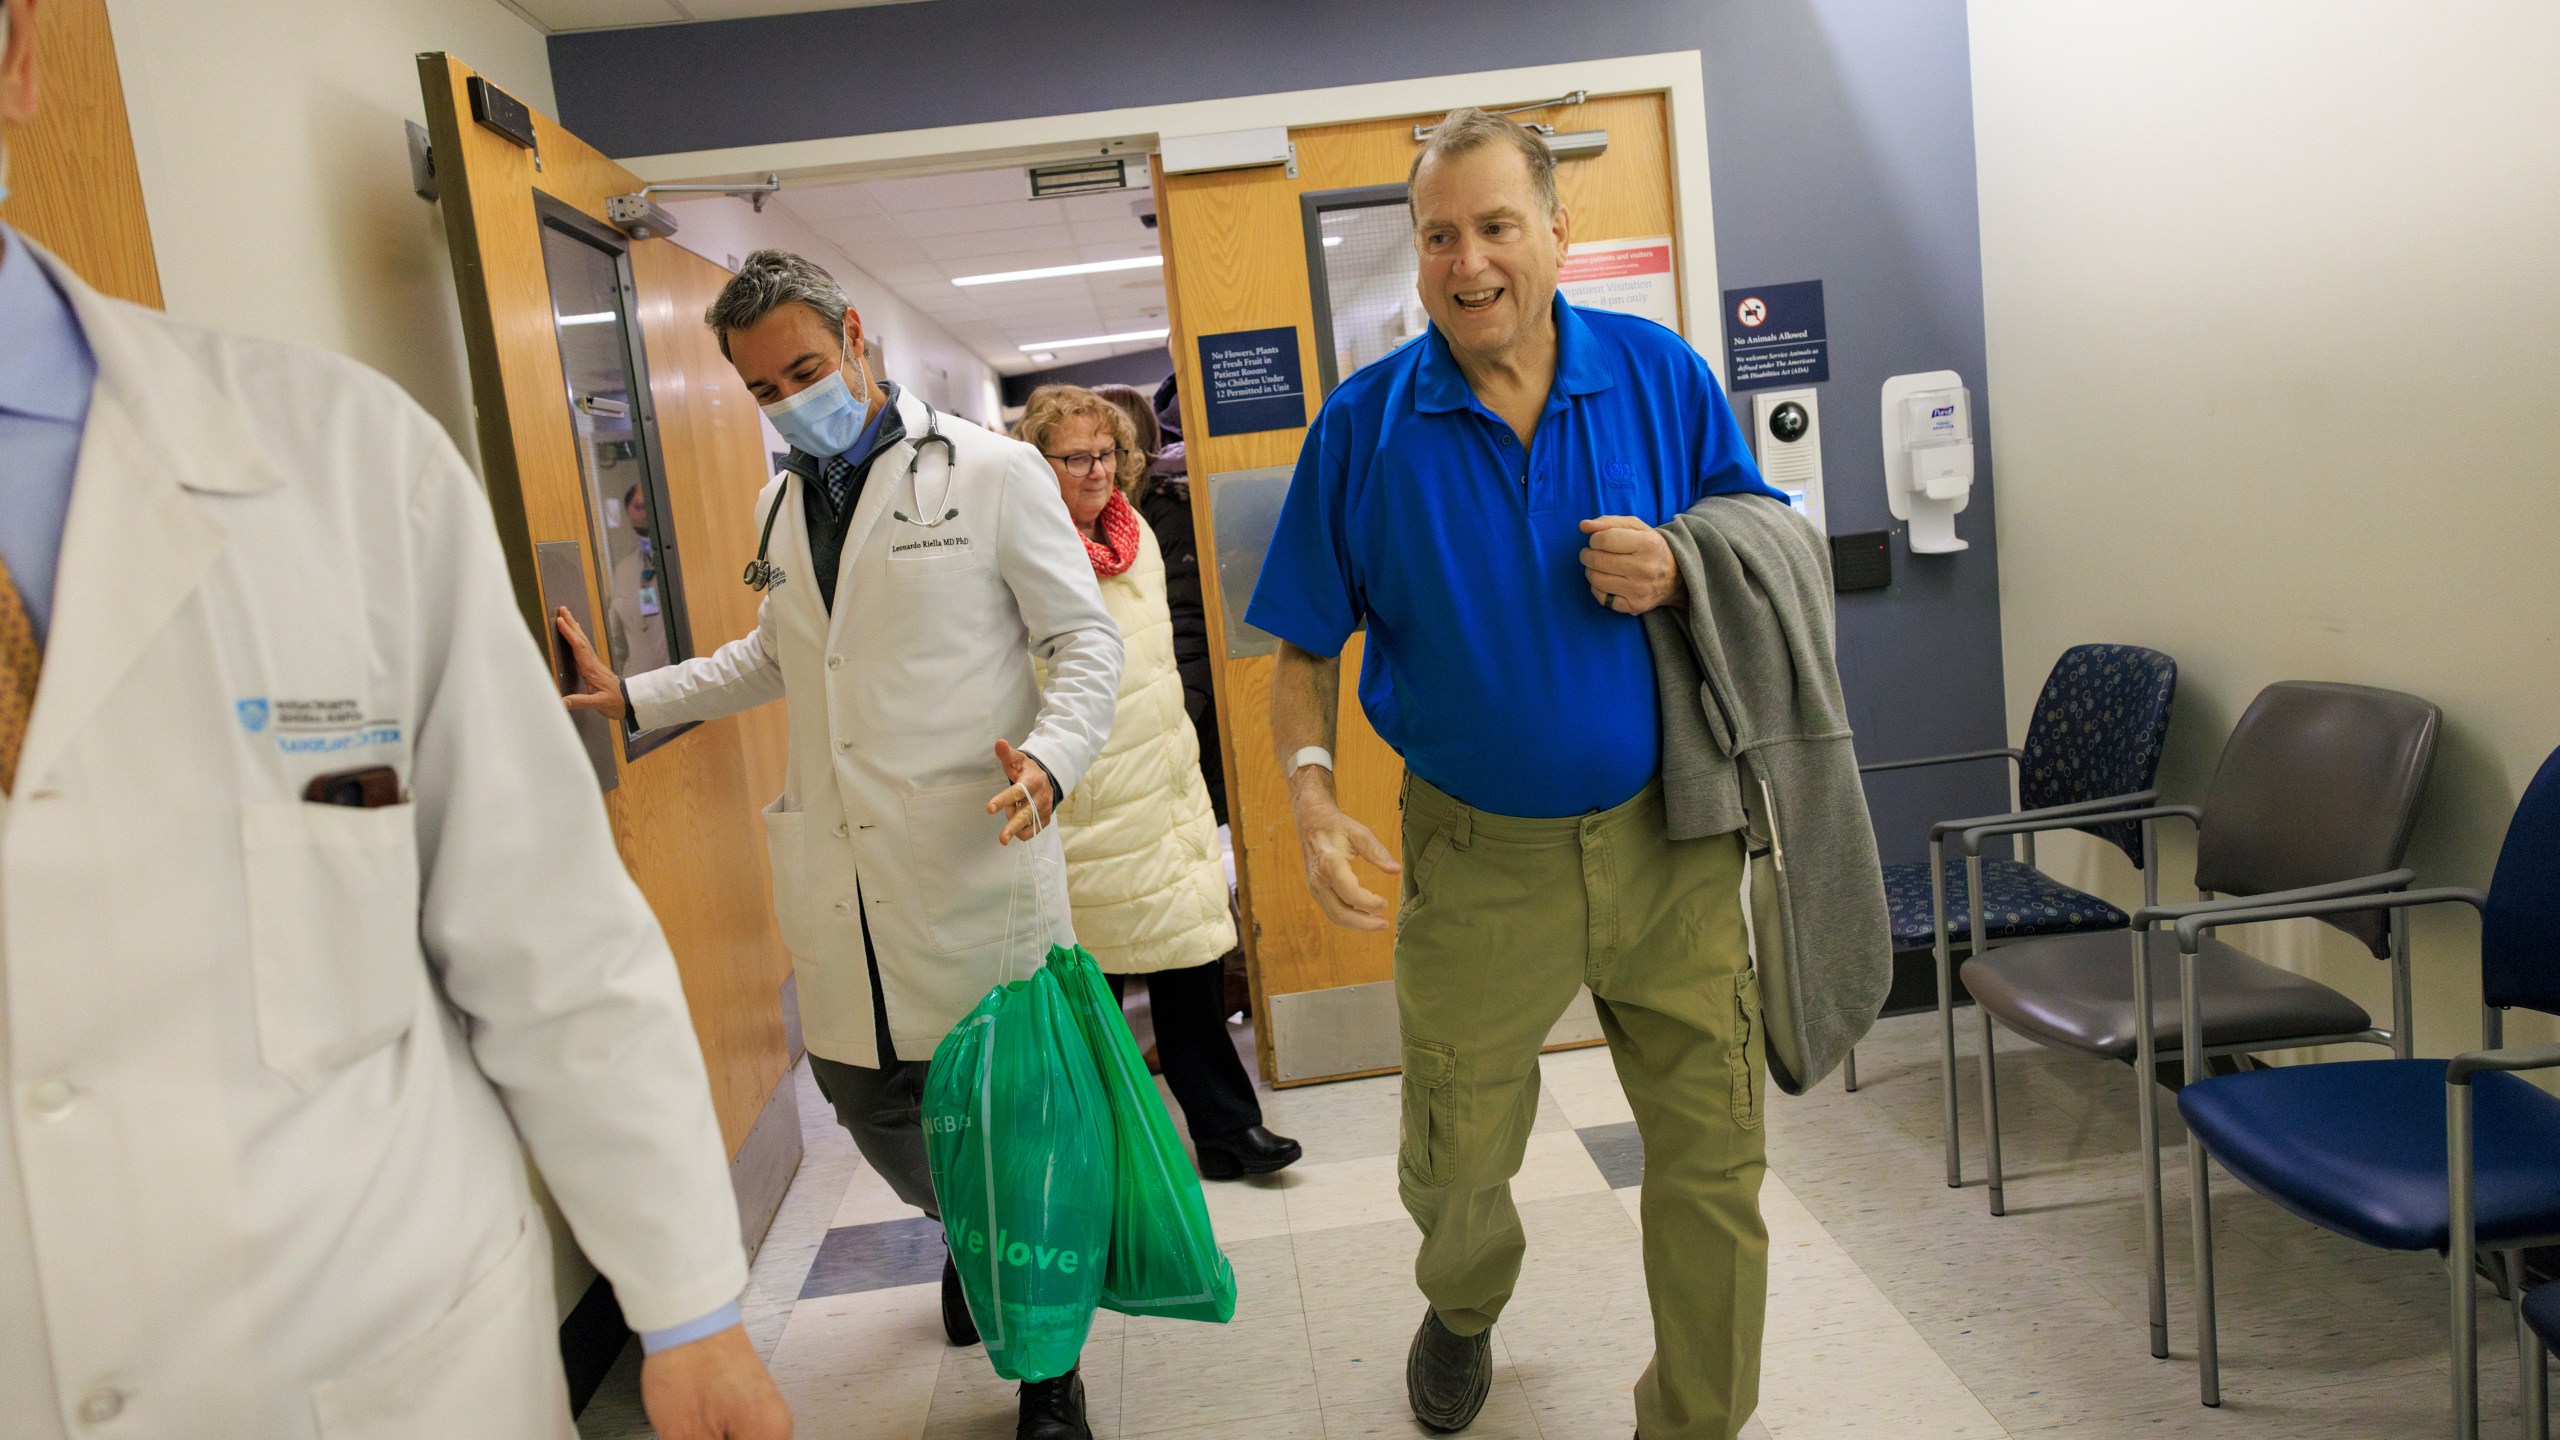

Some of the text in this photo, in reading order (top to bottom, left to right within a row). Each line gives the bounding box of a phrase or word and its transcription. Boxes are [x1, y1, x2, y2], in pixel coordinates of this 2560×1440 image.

[1616, 253, 1629, 261] and
[1630, 250, 1654, 259] visitors
[1606, 280, 1652, 292] Visitation
[1600, 297, 1607, 305] 8
[1609, 296, 1625, 307] pm
[1626, 292, 1648, 303] only
[1734, 329, 1808, 346] No Animals Allowed
[1212, 346, 1279, 360] No Flowers, Plants
[1745, 354, 1768, 362] welcome
[1768, 352, 1788, 360] Service
[1789, 349, 1812, 357] Animals
[1223, 360, 1242, 369] Fresh
[1244, 357, 1262, 366] Fruit
[1264, 356, 1272, 364] in
[1737, 364, 1759, 373] defined
[1759, 362, 1775, 370] under
[1787, 358, 1816, 366] Americans
[1214, 367, 1267, 379] Patient Rooms
[1750, 371, 1780, 379] Disabilities
[1791, 366, 1809, 375] (ADA)
[1215, 374, 1285, 389] No Children Under
[1216, 383, 1290, 398] 12 Permitted in Unit
[892, 537, 969, 553] Leonardo Riella MD PhD
[997, 1229, 1079, 1274] love
